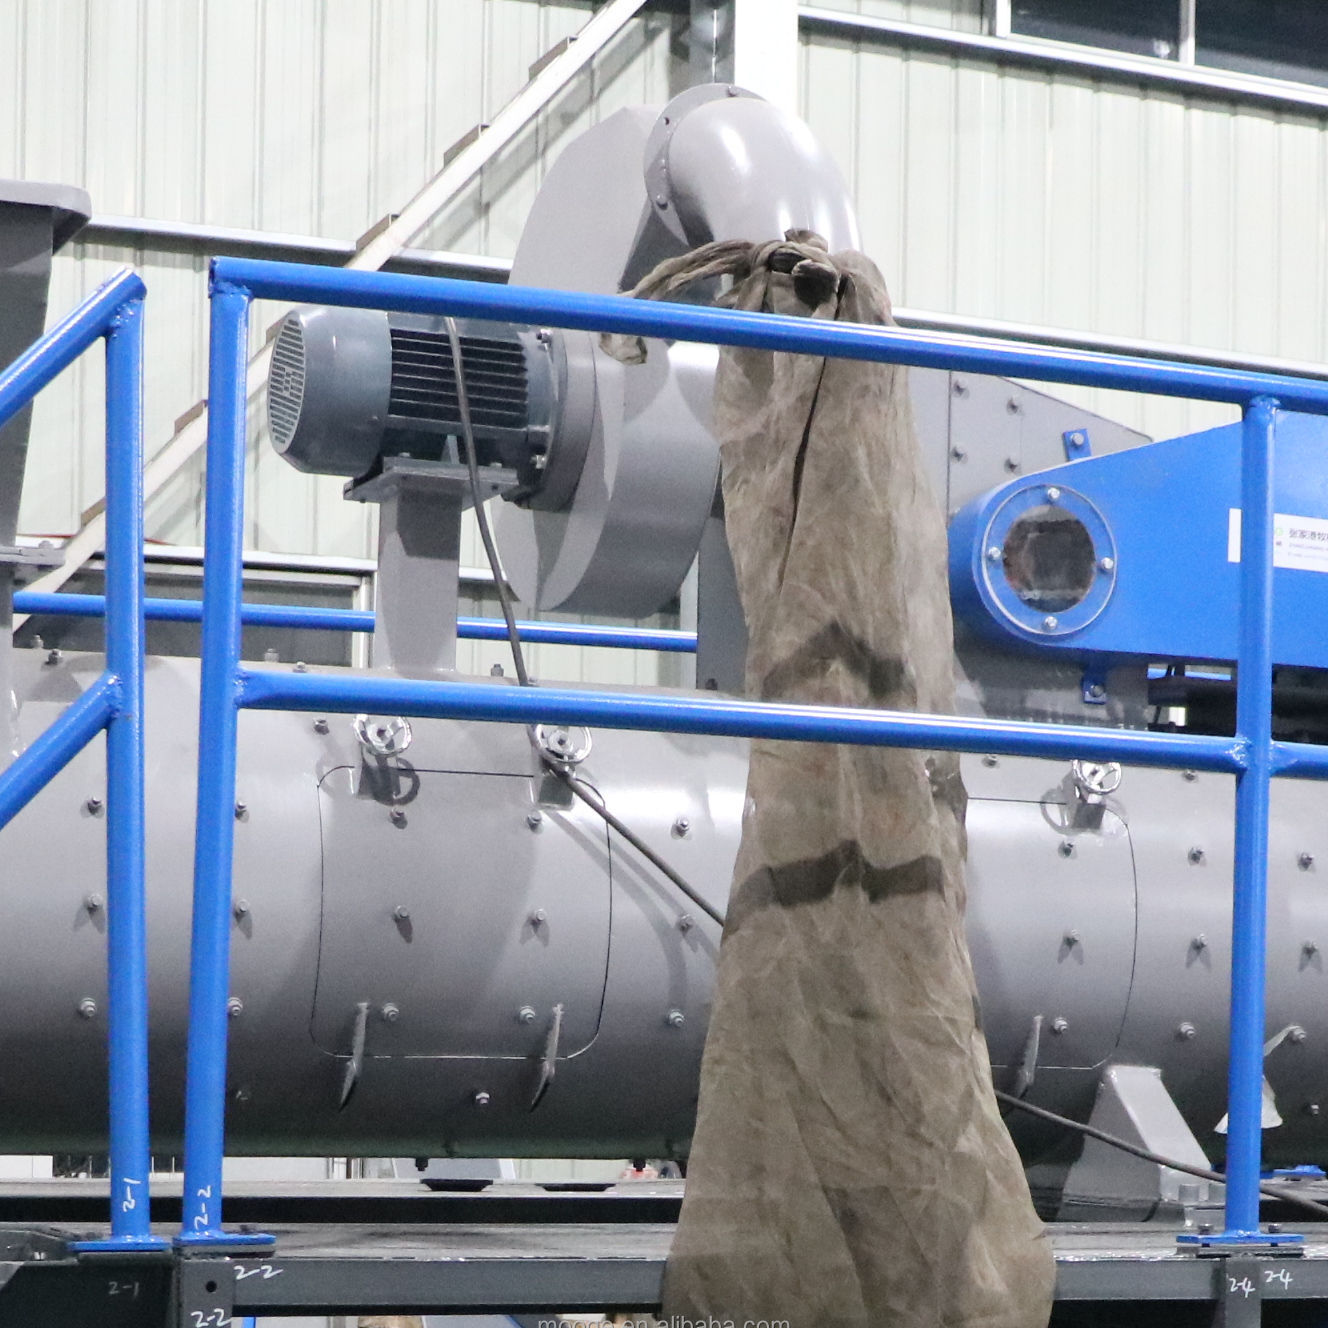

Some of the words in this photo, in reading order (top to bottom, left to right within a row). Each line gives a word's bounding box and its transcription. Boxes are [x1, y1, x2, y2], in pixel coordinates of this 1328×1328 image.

[122, 1177, 141, 1212] 2-1
[194, 1185, 211, 1230] 2-2
[109, 1281, 139, 1297] 2-1
[1228, 1277, 1255, 1298] 2-4
[1264, 1268, 1293, 1290] 2-4
[190, 1308, 233, 1328] 2-2
